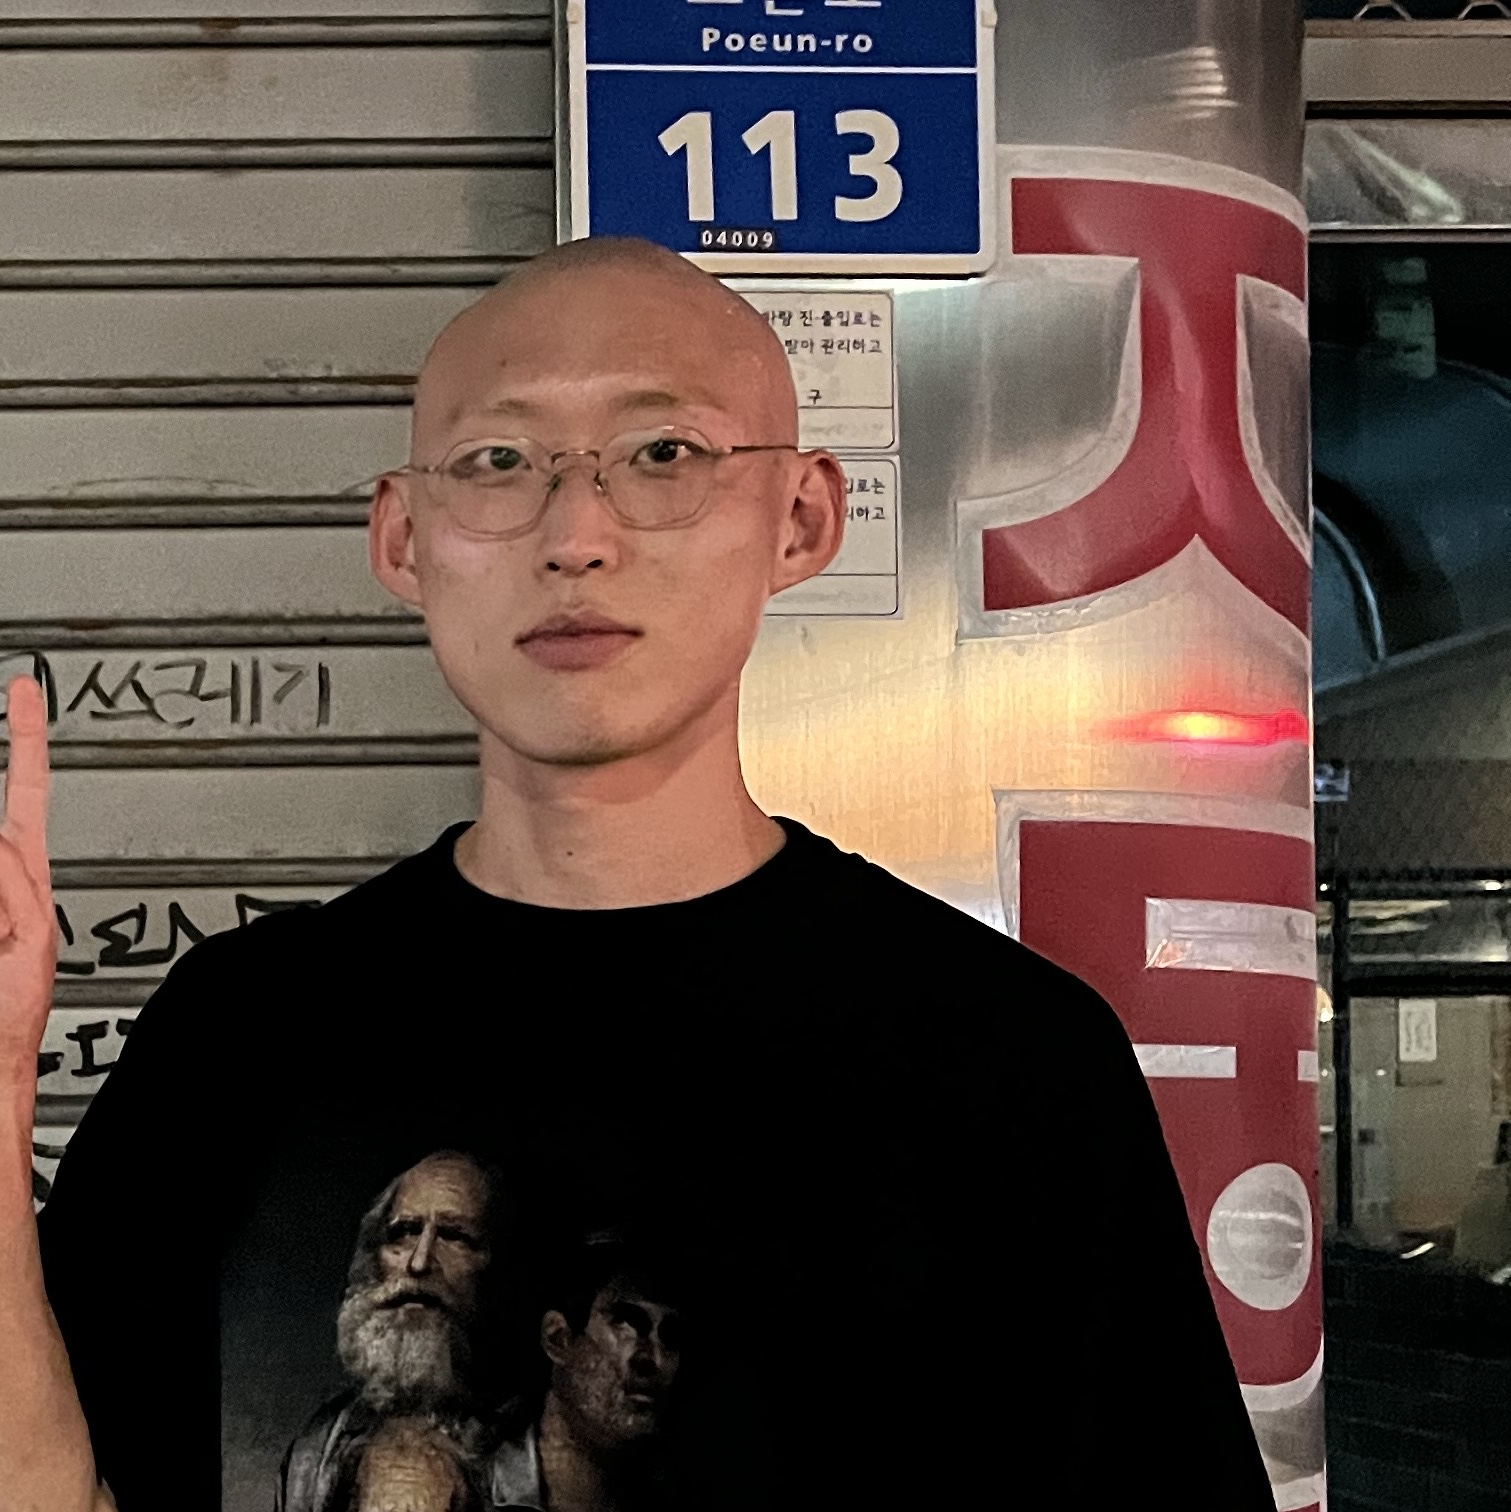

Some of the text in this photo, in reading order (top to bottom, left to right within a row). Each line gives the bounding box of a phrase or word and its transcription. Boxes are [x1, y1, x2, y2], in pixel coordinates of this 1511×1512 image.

[701, 27, 874, 54] Poeun-ro
[657, 108, 904, 223] 113
[701, 230, 775, 249] 04009
